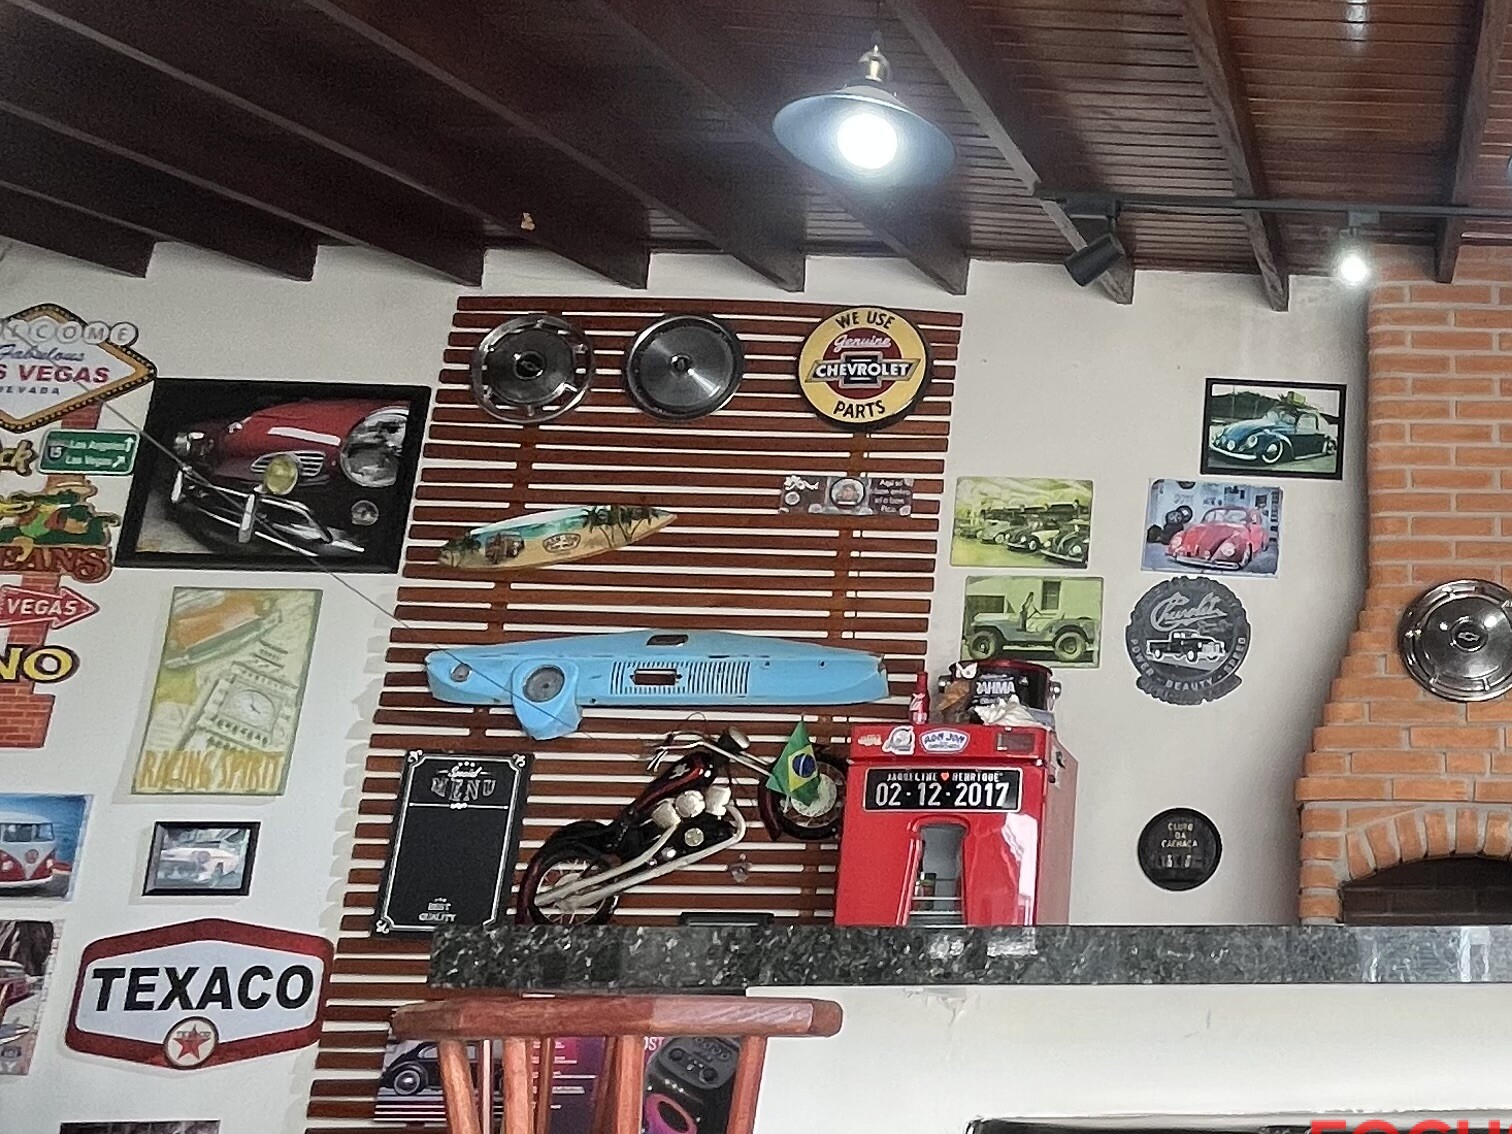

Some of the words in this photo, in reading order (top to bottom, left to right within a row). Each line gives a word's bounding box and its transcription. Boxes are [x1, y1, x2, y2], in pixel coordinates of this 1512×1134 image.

[834, 311, 860, 330] WE
[866, 310, 896, 330] USE
[833, 334, 892, 353] Genuine
[18, 363, 111, 384] VEGAS
[815, 362, 911, 378] CHEVROLET
[833, 399, 887, 419] PARTS
[7, 598, 79, 616] VEGAS
[976, 680, 1016, 695] AHMA
[952, 771, 1000, 783] HENRIQUE
[430, 777, 497, 802] MENU
[91, 964, 315, 1012] TEXACO
